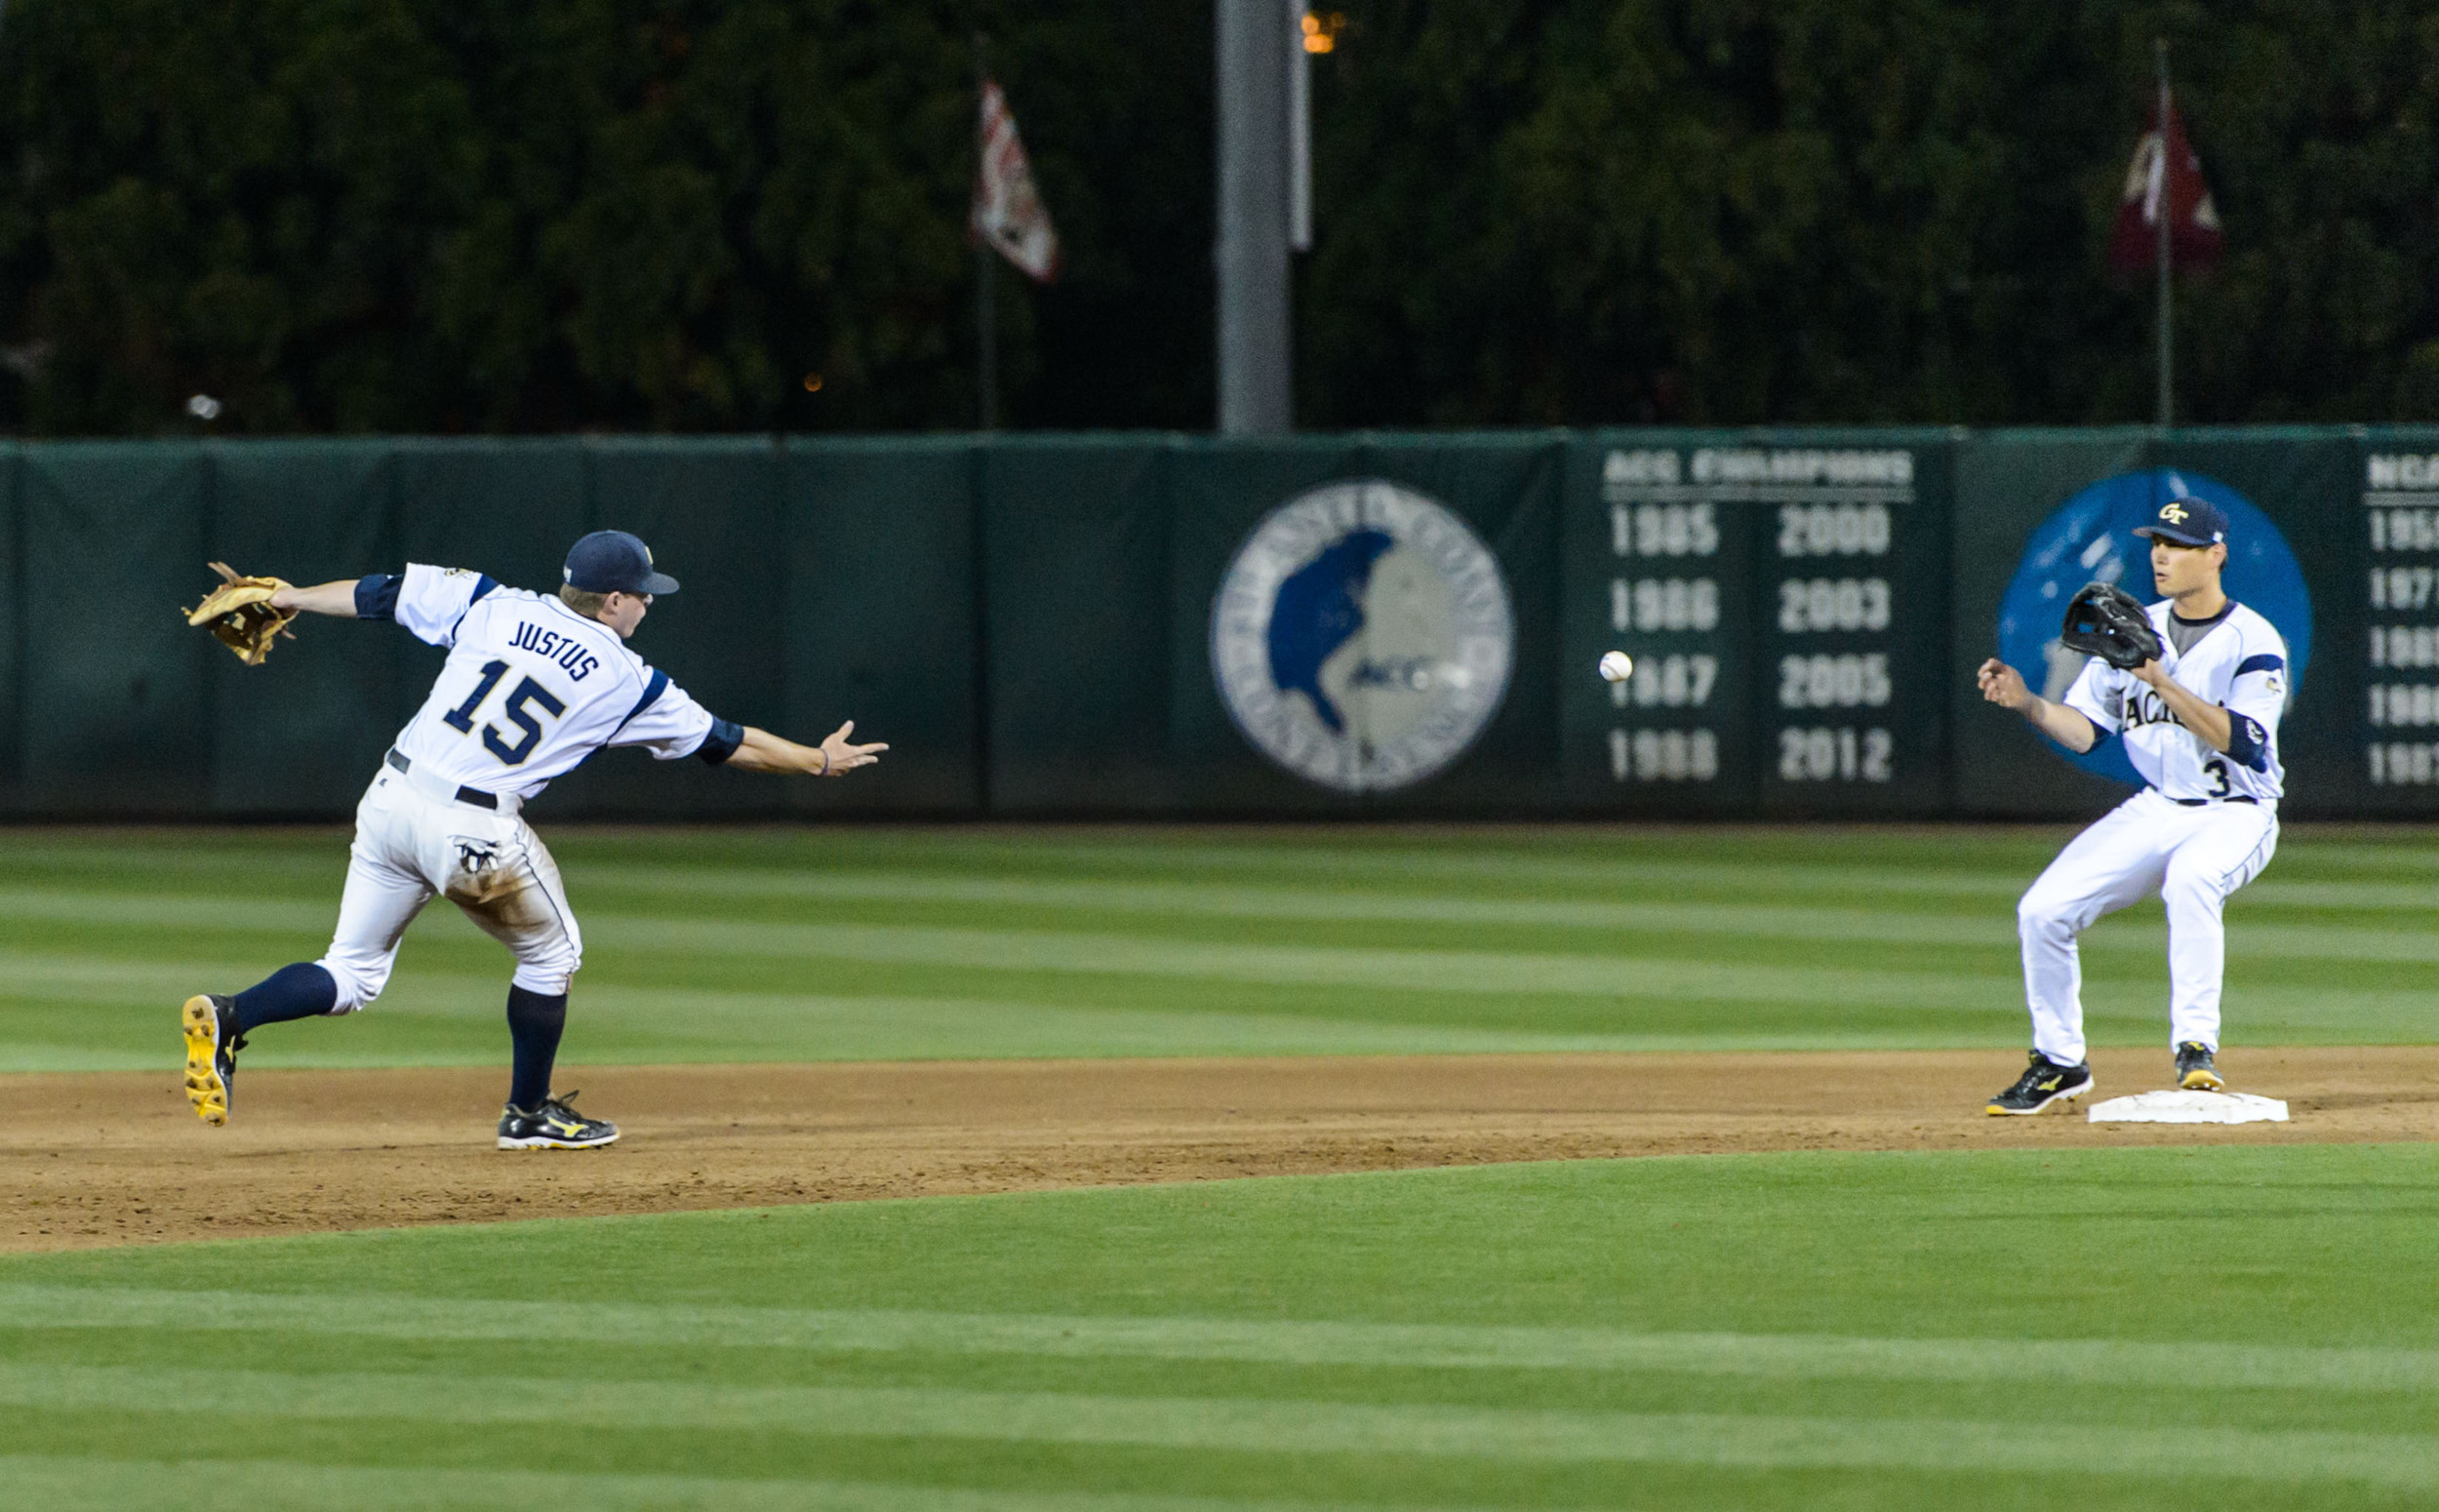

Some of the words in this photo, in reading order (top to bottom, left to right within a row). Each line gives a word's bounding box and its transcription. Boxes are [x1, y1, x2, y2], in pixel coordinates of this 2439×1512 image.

[1605, 450, 1679, 482] ACC
[1693, 449, 1913, 482] CHAMPIONS
[1613, 504, 1718, 556] 1985
[1779, 504, 1890, 557] 2000
[2159, 503, 2188, 525] GT
[2370, 509, 2439, 551] 195
[1612, 578, 1719, 631] 1986
[1779, 577, 1890, 632] 2003
[2370, 567, 2439, 610] 197
[508, 621, 598, 682] JUSTUS
[2370, 625, 2439, 667] 198
[1779, 654, 1891, 707] 2005
[2369, 683, 2439, 726] 198
[443, 659, 568, 768] 15
[1609, 728, 1718, 781] 1988
[1779, 727, 1892, 781] 2012
[2204, 760, 2230, 798] 3
[2369, 742, 2439, 784] 198
